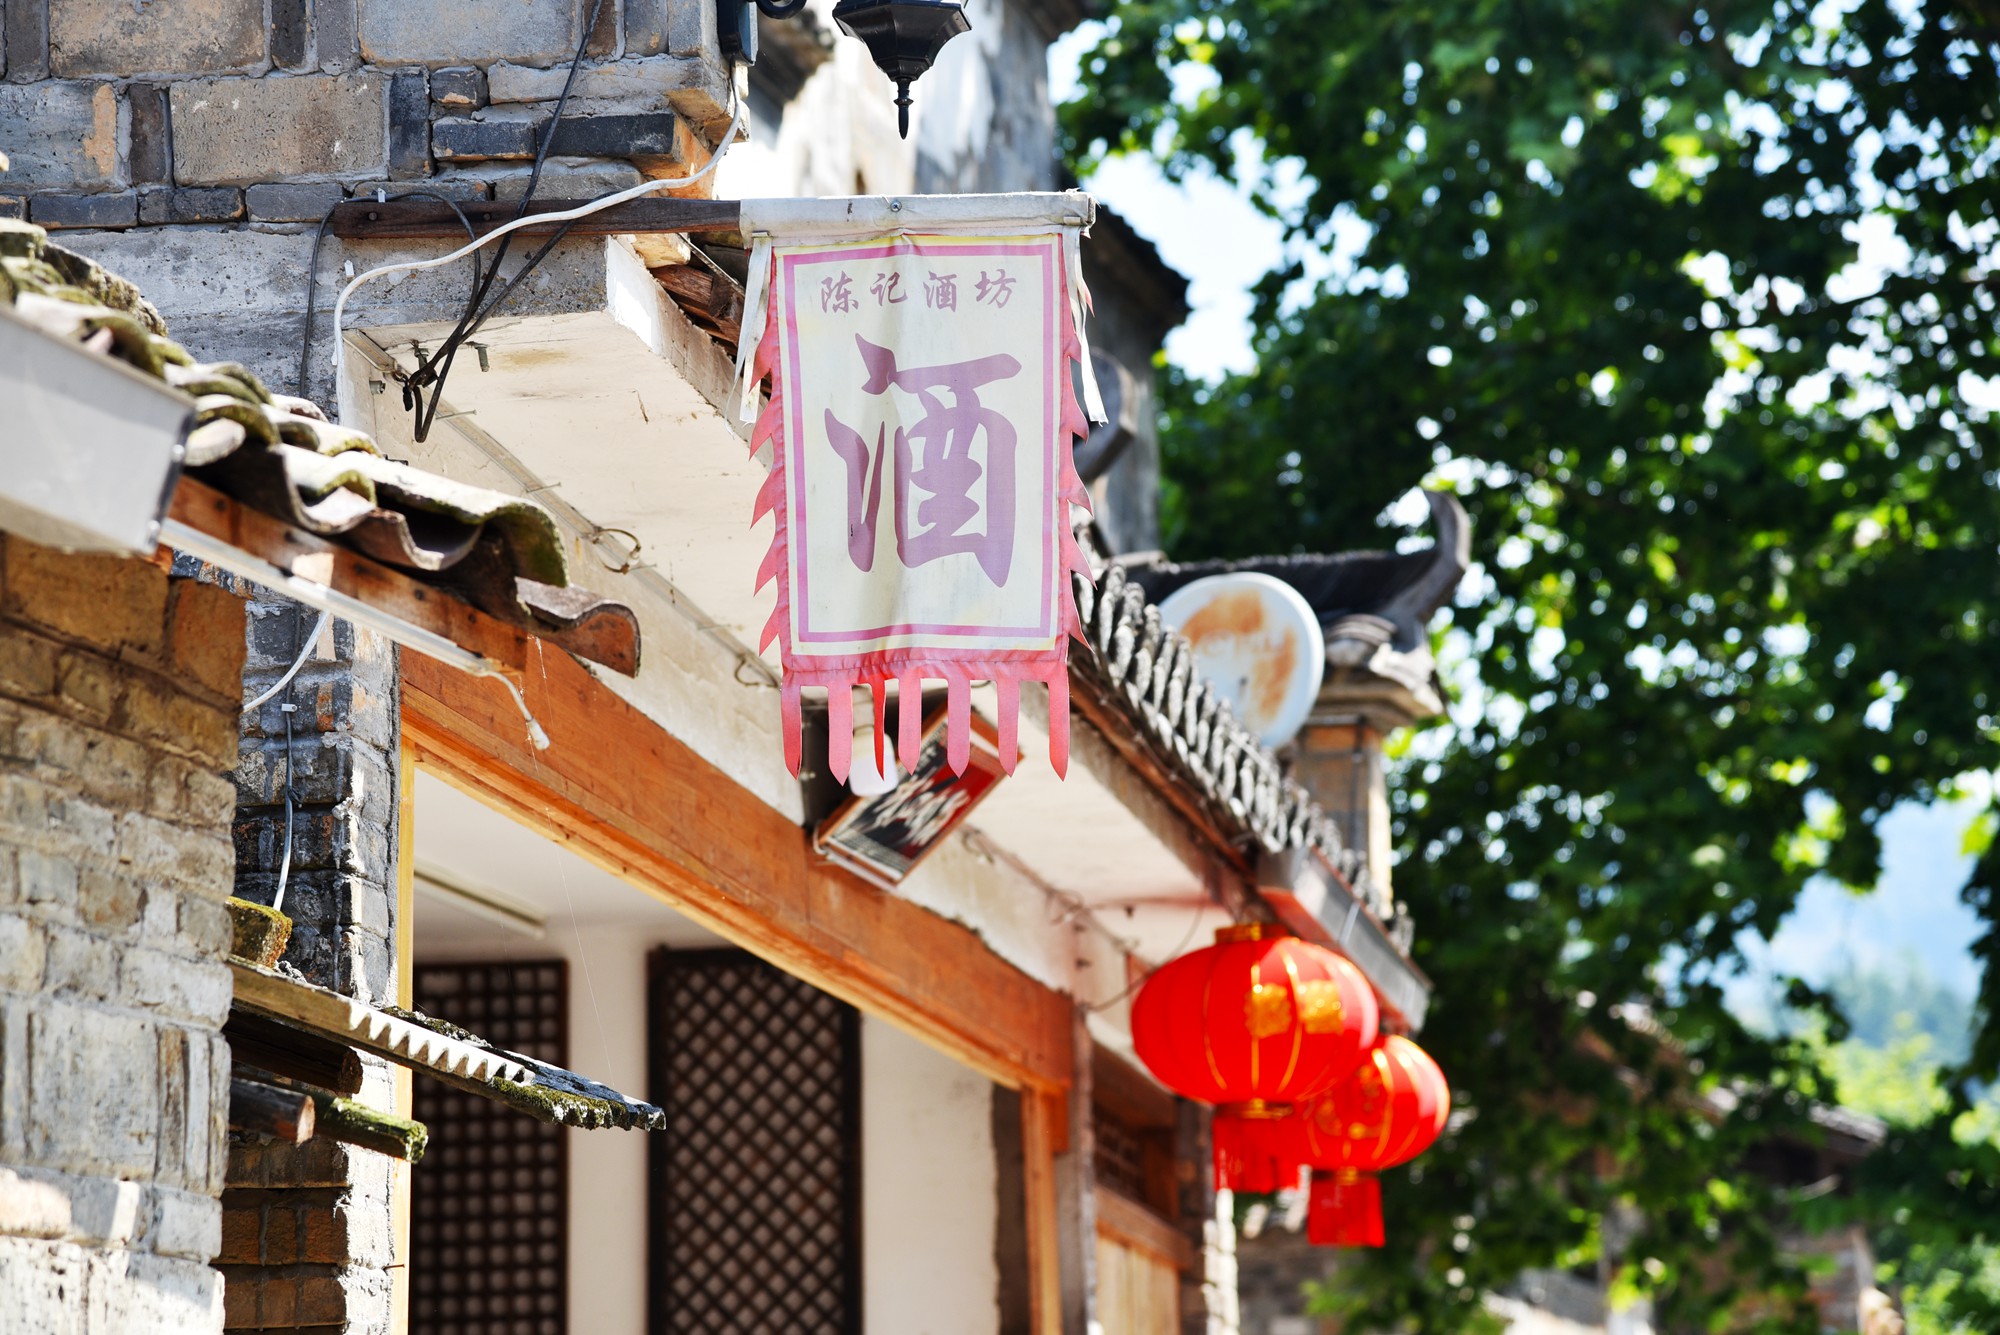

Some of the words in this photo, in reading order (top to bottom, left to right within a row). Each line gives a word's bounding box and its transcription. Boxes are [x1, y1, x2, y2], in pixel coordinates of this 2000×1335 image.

[821, 269, 1017, 314] 陈记酒坊
[824, 333, 1022, 588] 酒
